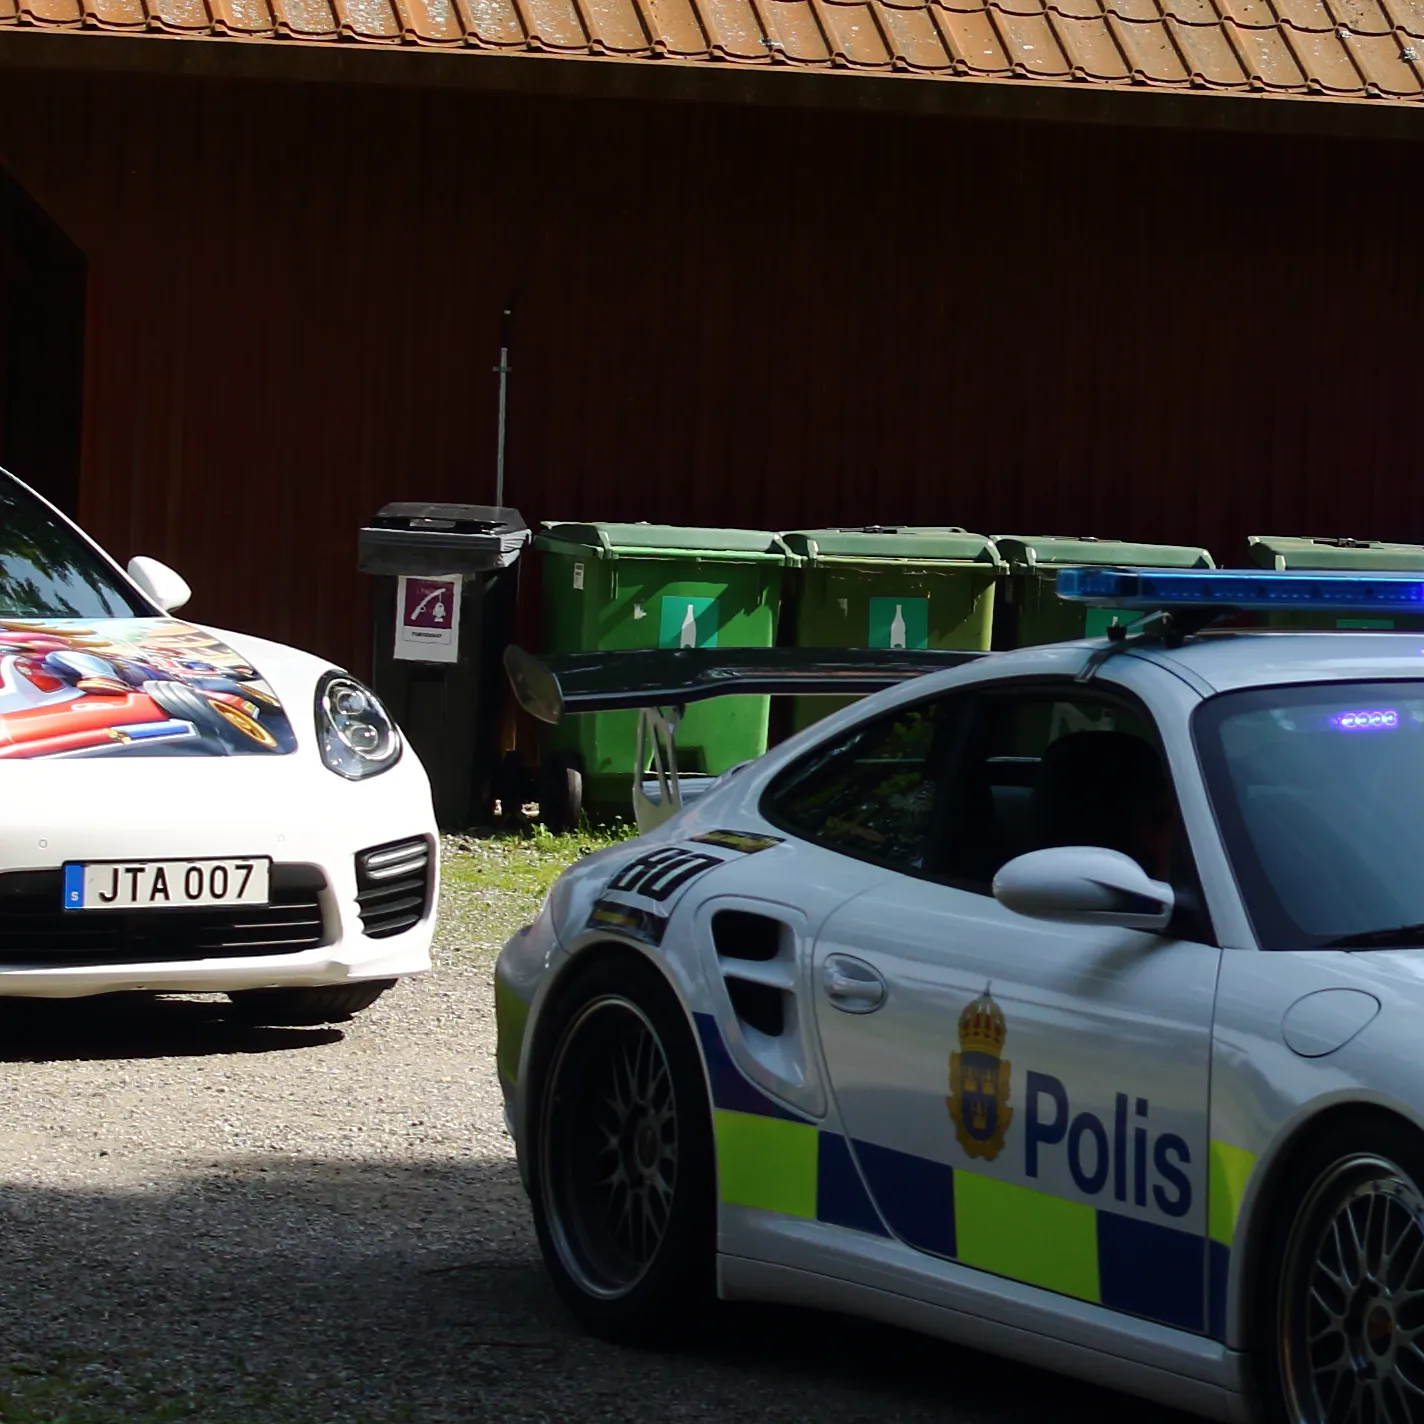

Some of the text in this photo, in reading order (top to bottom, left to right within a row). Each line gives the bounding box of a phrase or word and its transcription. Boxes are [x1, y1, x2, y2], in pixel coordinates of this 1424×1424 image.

[70, 891, 79, 901] S
[98, 863, 254, 903] JTA 007
[607, 847, 725, 902] 80
[1025, 1070, 1192, 1217] Polis
